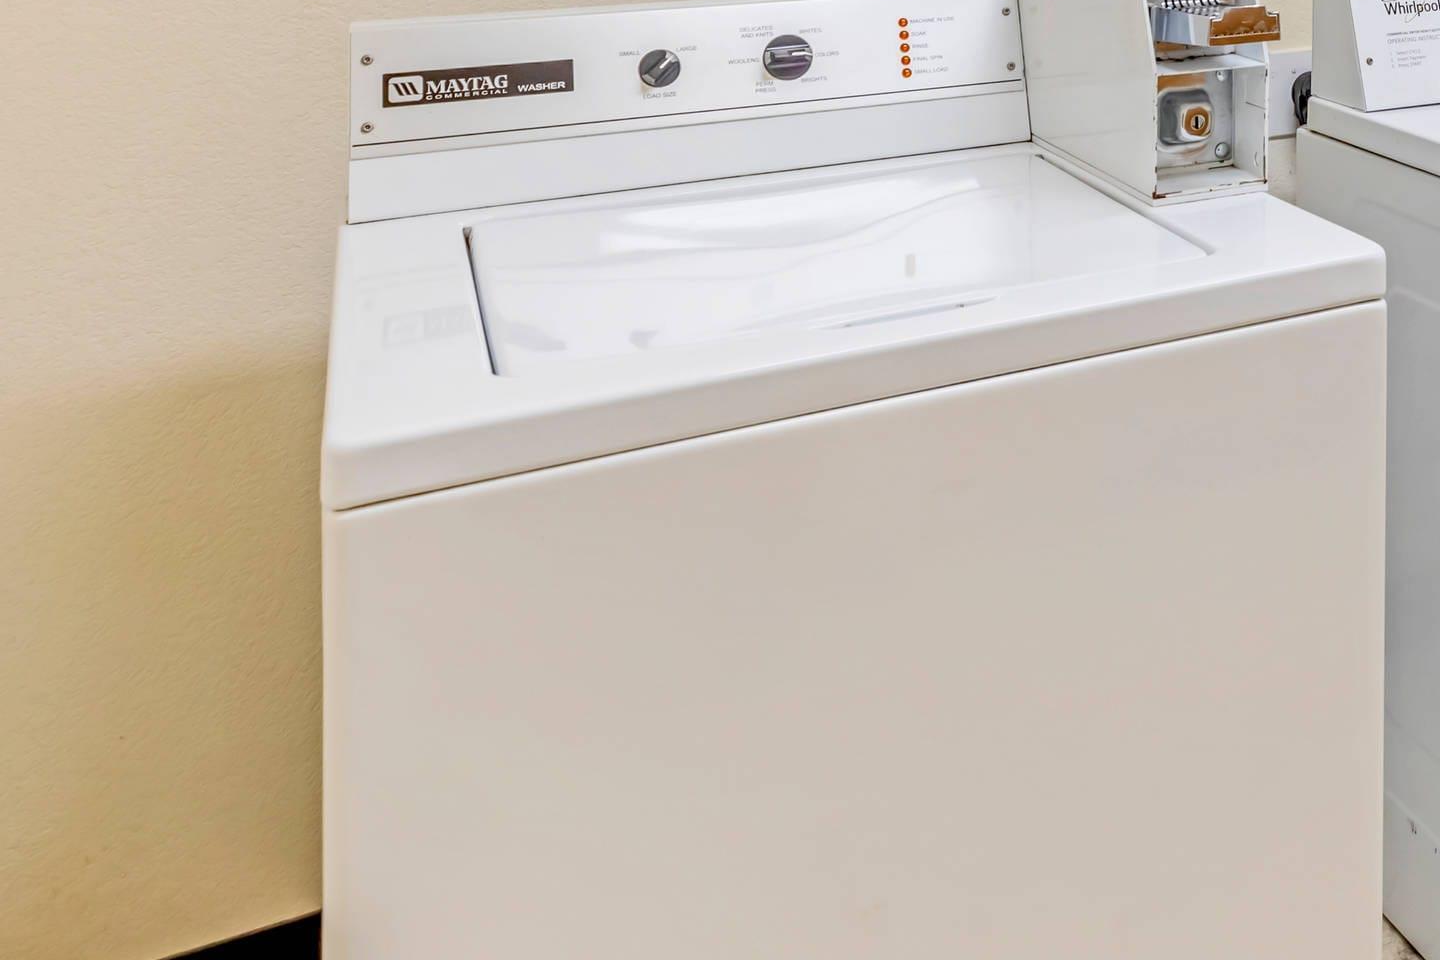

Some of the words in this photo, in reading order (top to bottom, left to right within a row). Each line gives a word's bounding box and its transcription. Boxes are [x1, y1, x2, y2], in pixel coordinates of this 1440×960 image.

[426, 74, 508, 94] MAYTAG
[517, 81, 566, 93] WASHER
[425, 90, 508, 101] COMMERCIAL
[643, 92, 661, 100] LOAD
